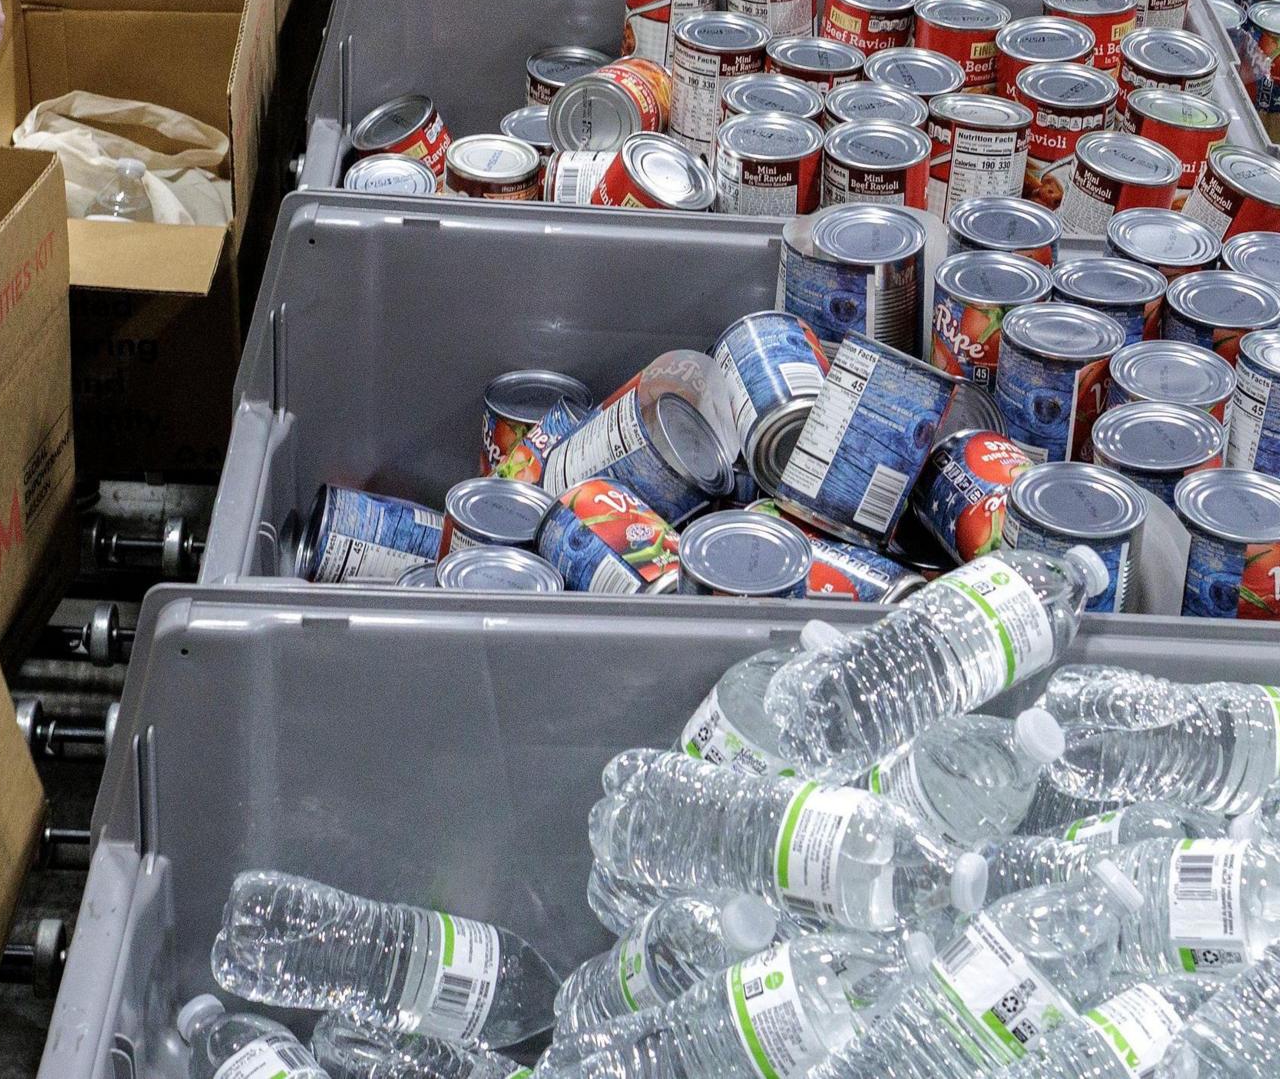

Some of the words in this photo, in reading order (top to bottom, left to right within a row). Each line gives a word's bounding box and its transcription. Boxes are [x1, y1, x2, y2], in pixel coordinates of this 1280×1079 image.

[1150, 0, 1166, 8] Beef
[756, 6, 768, 16] 330
[825, 20, 851, 41] Beef
[851, 33, 896, 50] Ravioli
[735, 55, 752, 64] Mini
[722, 63, 740, 72] Beef
[965, 59, 992, 73] Beef
[702, 79, 716, 89] 330
[957, 132, 993, 143] Nutrition
[994, 135, 1013, 143] Facts
[757, 165, 777, 174] Mini
[954, 159, 976, 169] Calories
[981, 161, 995, 170] 190
[998, 160, 1010, 170] 330
[744, 171, 761, 181] Beef
[761, 173, 792, 183] Ravioli
[864, 173, 884, 183] Mini
[1084, 170, 1100, 186] Mini
[851, 180, 869, 191] Beef
[870, 181, 899, 191] Ravioli
[1086, 179, 1111, 199] Ravioli
[1210, 177, 1224, 194] Mini
[1209, 189, 1233, 210] Ravioli
[31, 231, 57, 274] KIT
[935, 304, 984, 358] Ripe
[860, 349, 877, 364] Facts
[976, 368, 987, 379] 45
[851, 380, 864, 392] 45
[1251, 376, 1270, 387] Facts
[1251, 406, 1264, 416] 45
[614, 444, 625, 458] 45
[355, 542, 364, 554] 45
